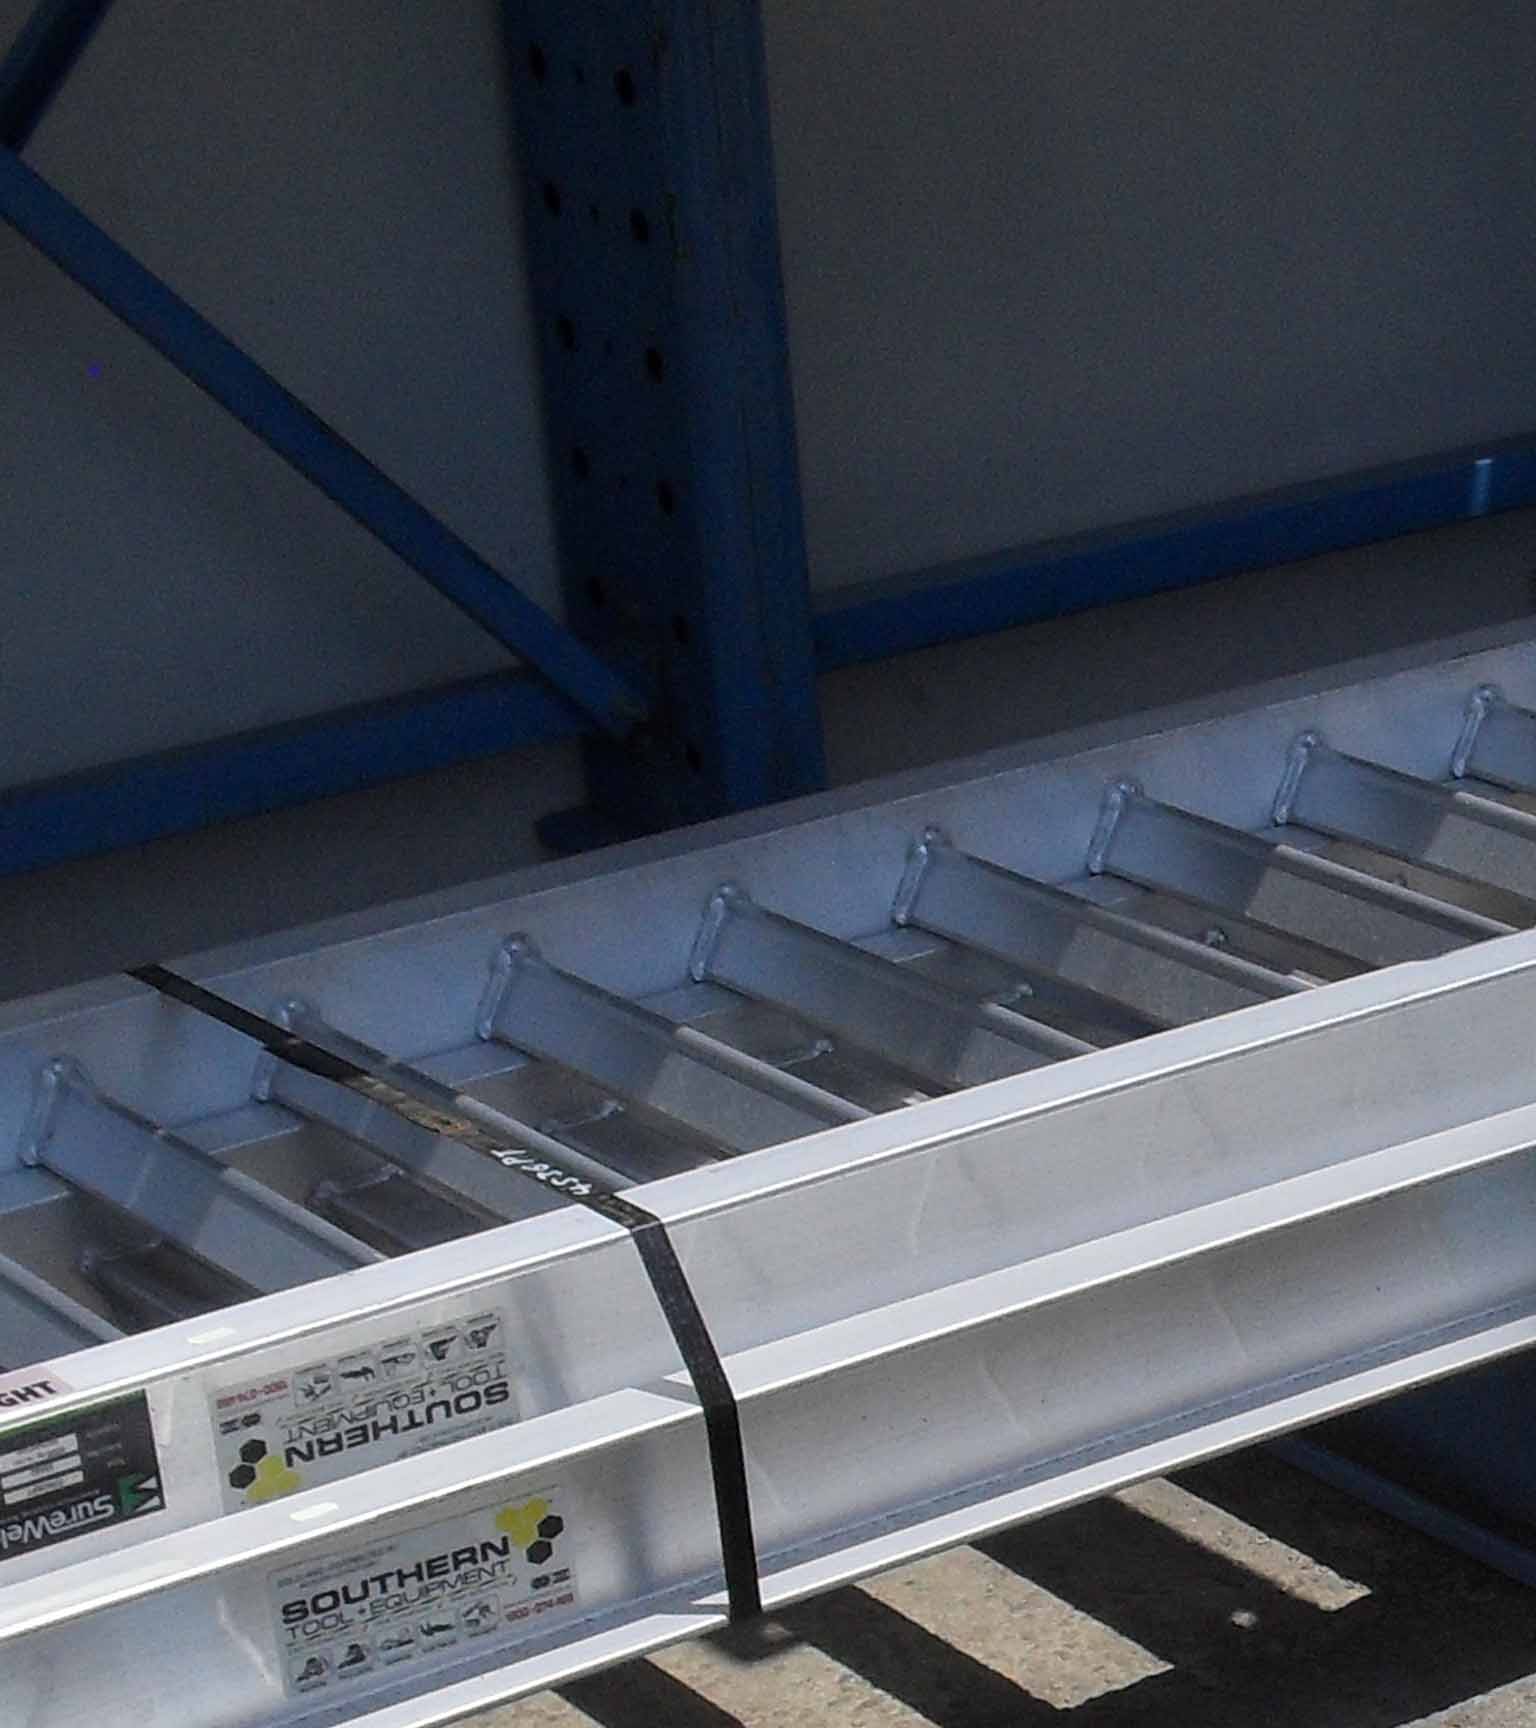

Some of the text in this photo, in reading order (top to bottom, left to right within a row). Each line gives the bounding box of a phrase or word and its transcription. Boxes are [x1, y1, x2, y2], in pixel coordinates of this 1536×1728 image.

[448, 1365, 510, 1394] TOOL
[283, 1380, 510, 1469] SOUTHERN
[281, 1535, 511, 1626] SOUTHERN
[287, 1611, 355, 1640] TOOL
[368, 1560, 511, 1616] EQUIPMENT
